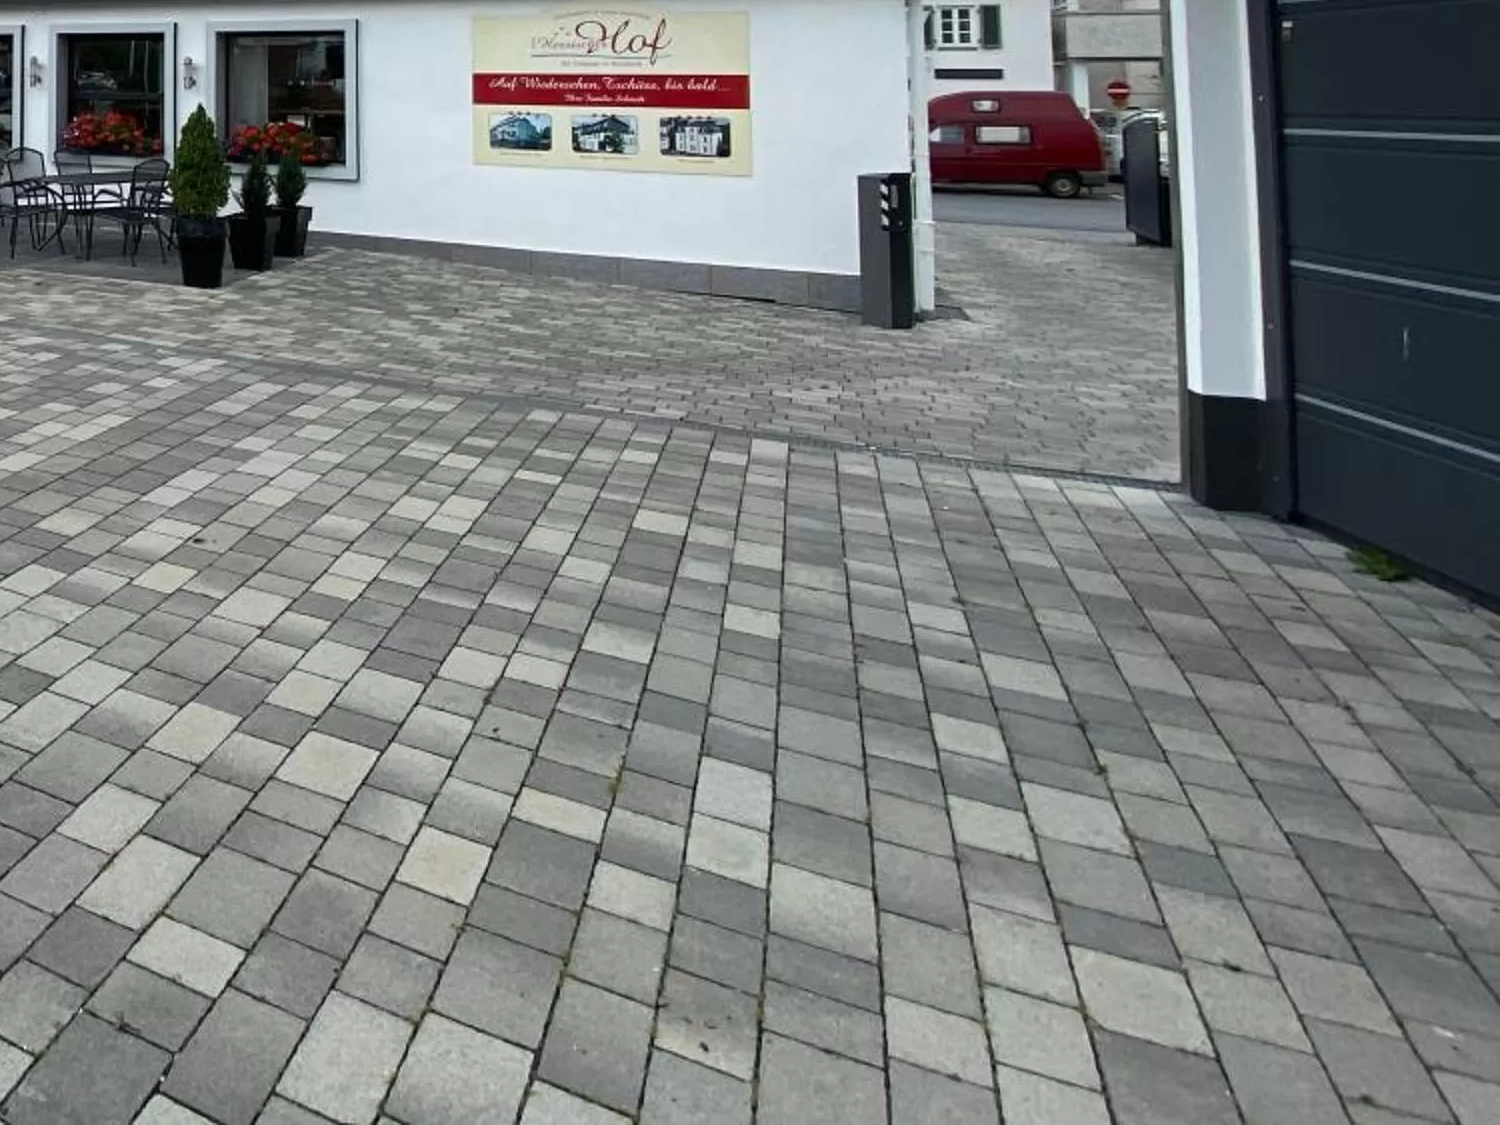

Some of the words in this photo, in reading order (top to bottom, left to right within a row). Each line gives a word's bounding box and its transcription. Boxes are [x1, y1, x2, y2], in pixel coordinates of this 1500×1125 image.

[575, 17, 673, 67] Hof
[488, 76, 517, 91] Auf
[664, 76, 684, 90] bis
